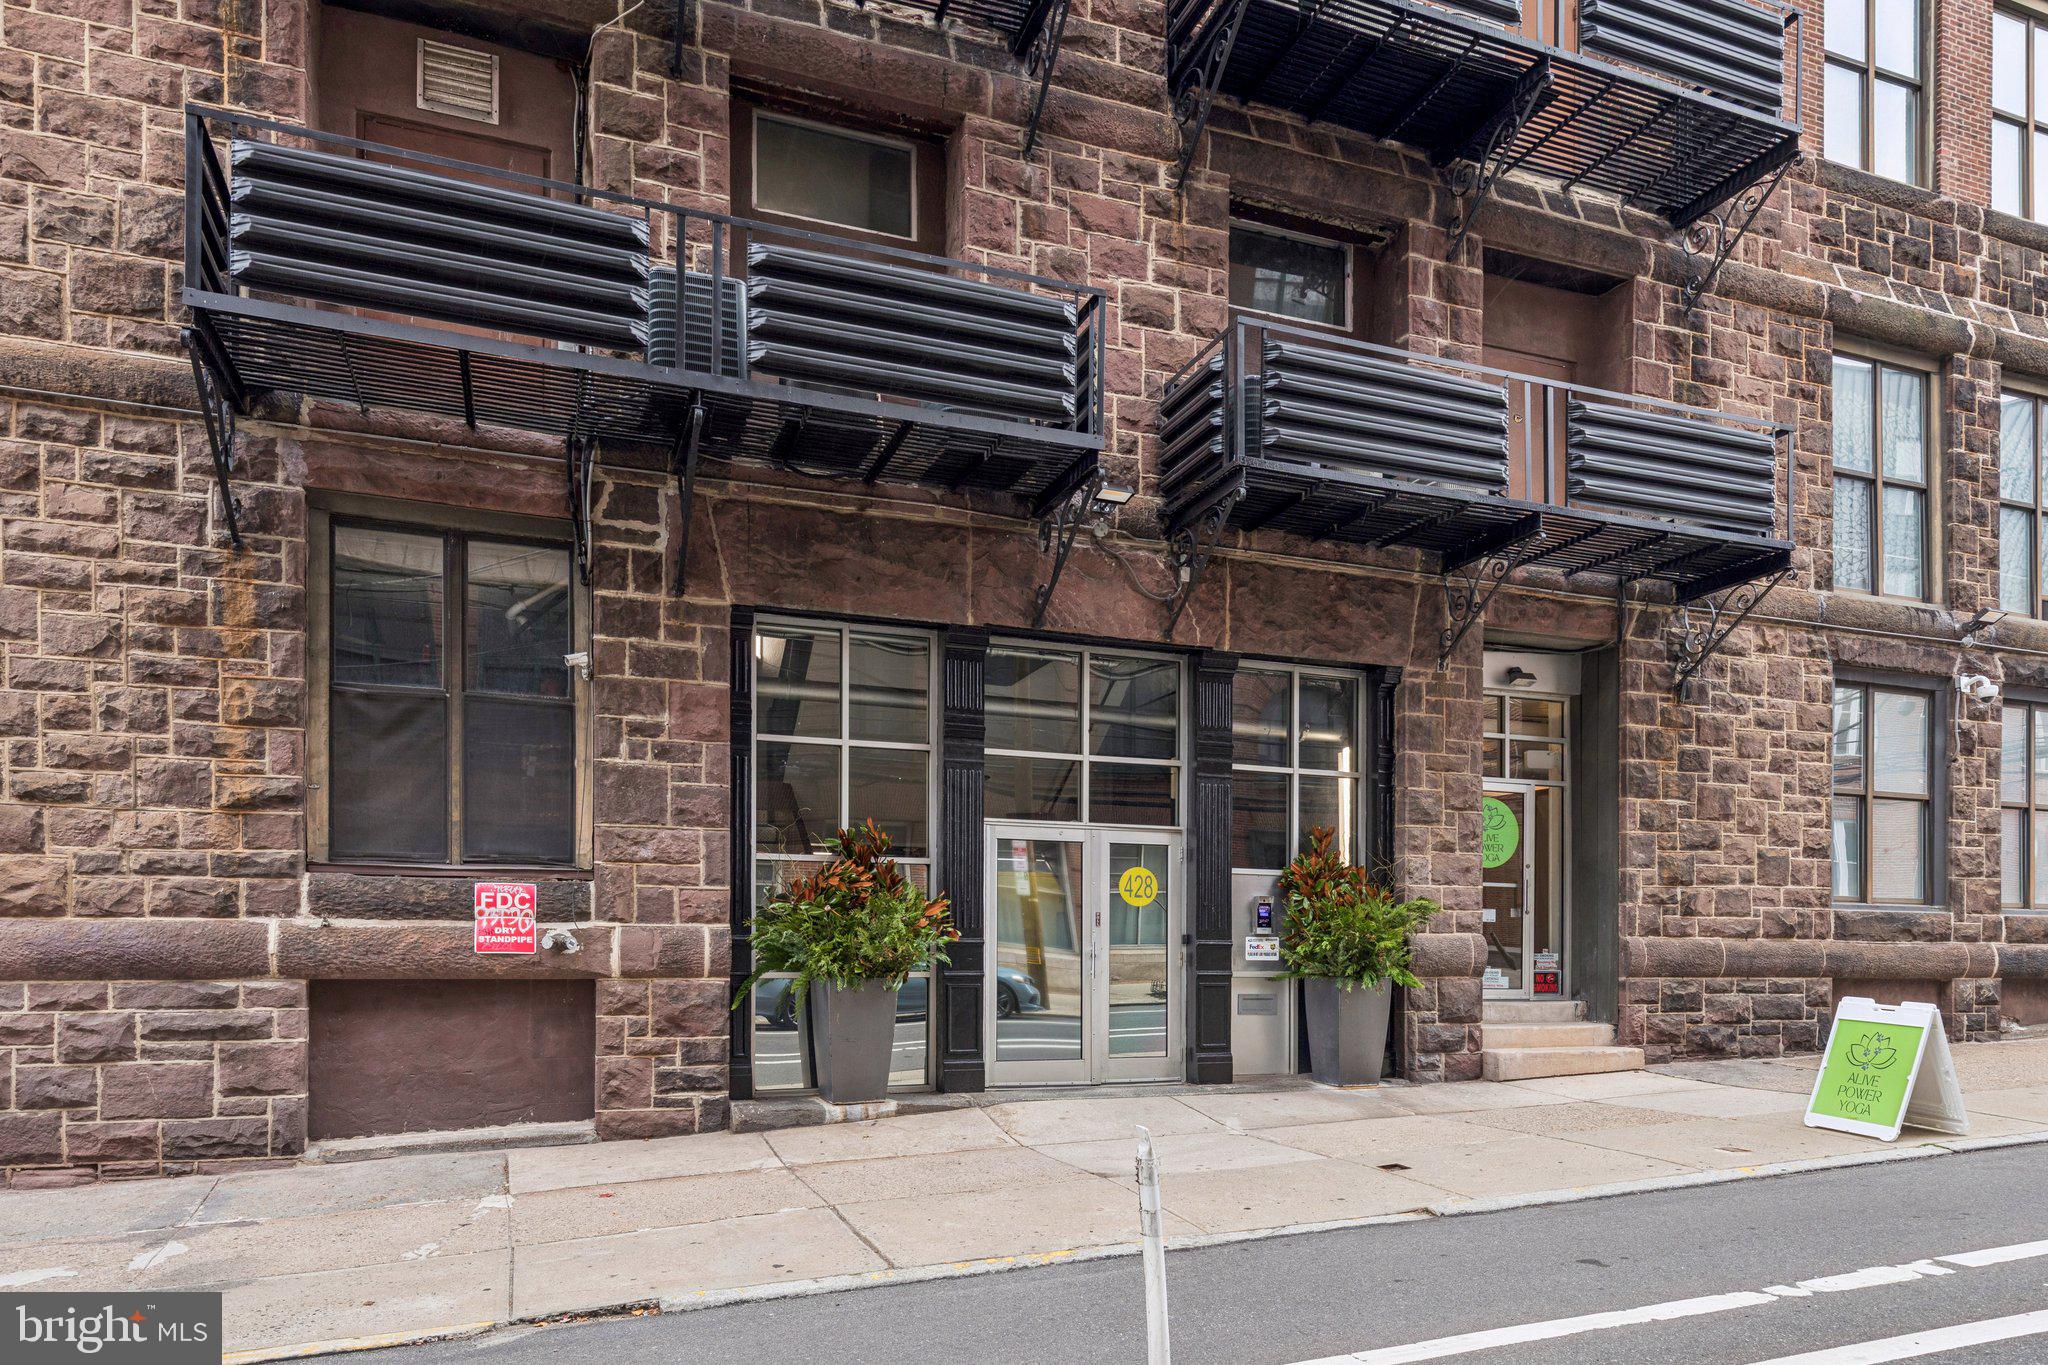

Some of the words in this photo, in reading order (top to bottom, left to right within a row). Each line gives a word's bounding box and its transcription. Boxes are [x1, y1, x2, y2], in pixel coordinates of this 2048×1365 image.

[1124, 875, 1153, 899] 428
[480, 892, 531, 910] FDC
[478, 935, 533, 943] STANDPIPE
[1535, 973, 1545, 983] NO
[1534, 983, 1559, 993] SMOKING
[1847, 1072, 1881, 1088] ALIVE
[1837, 1084, 1883, 1103] POWER
[1839, 1099, 1872, 1116] YOGA
